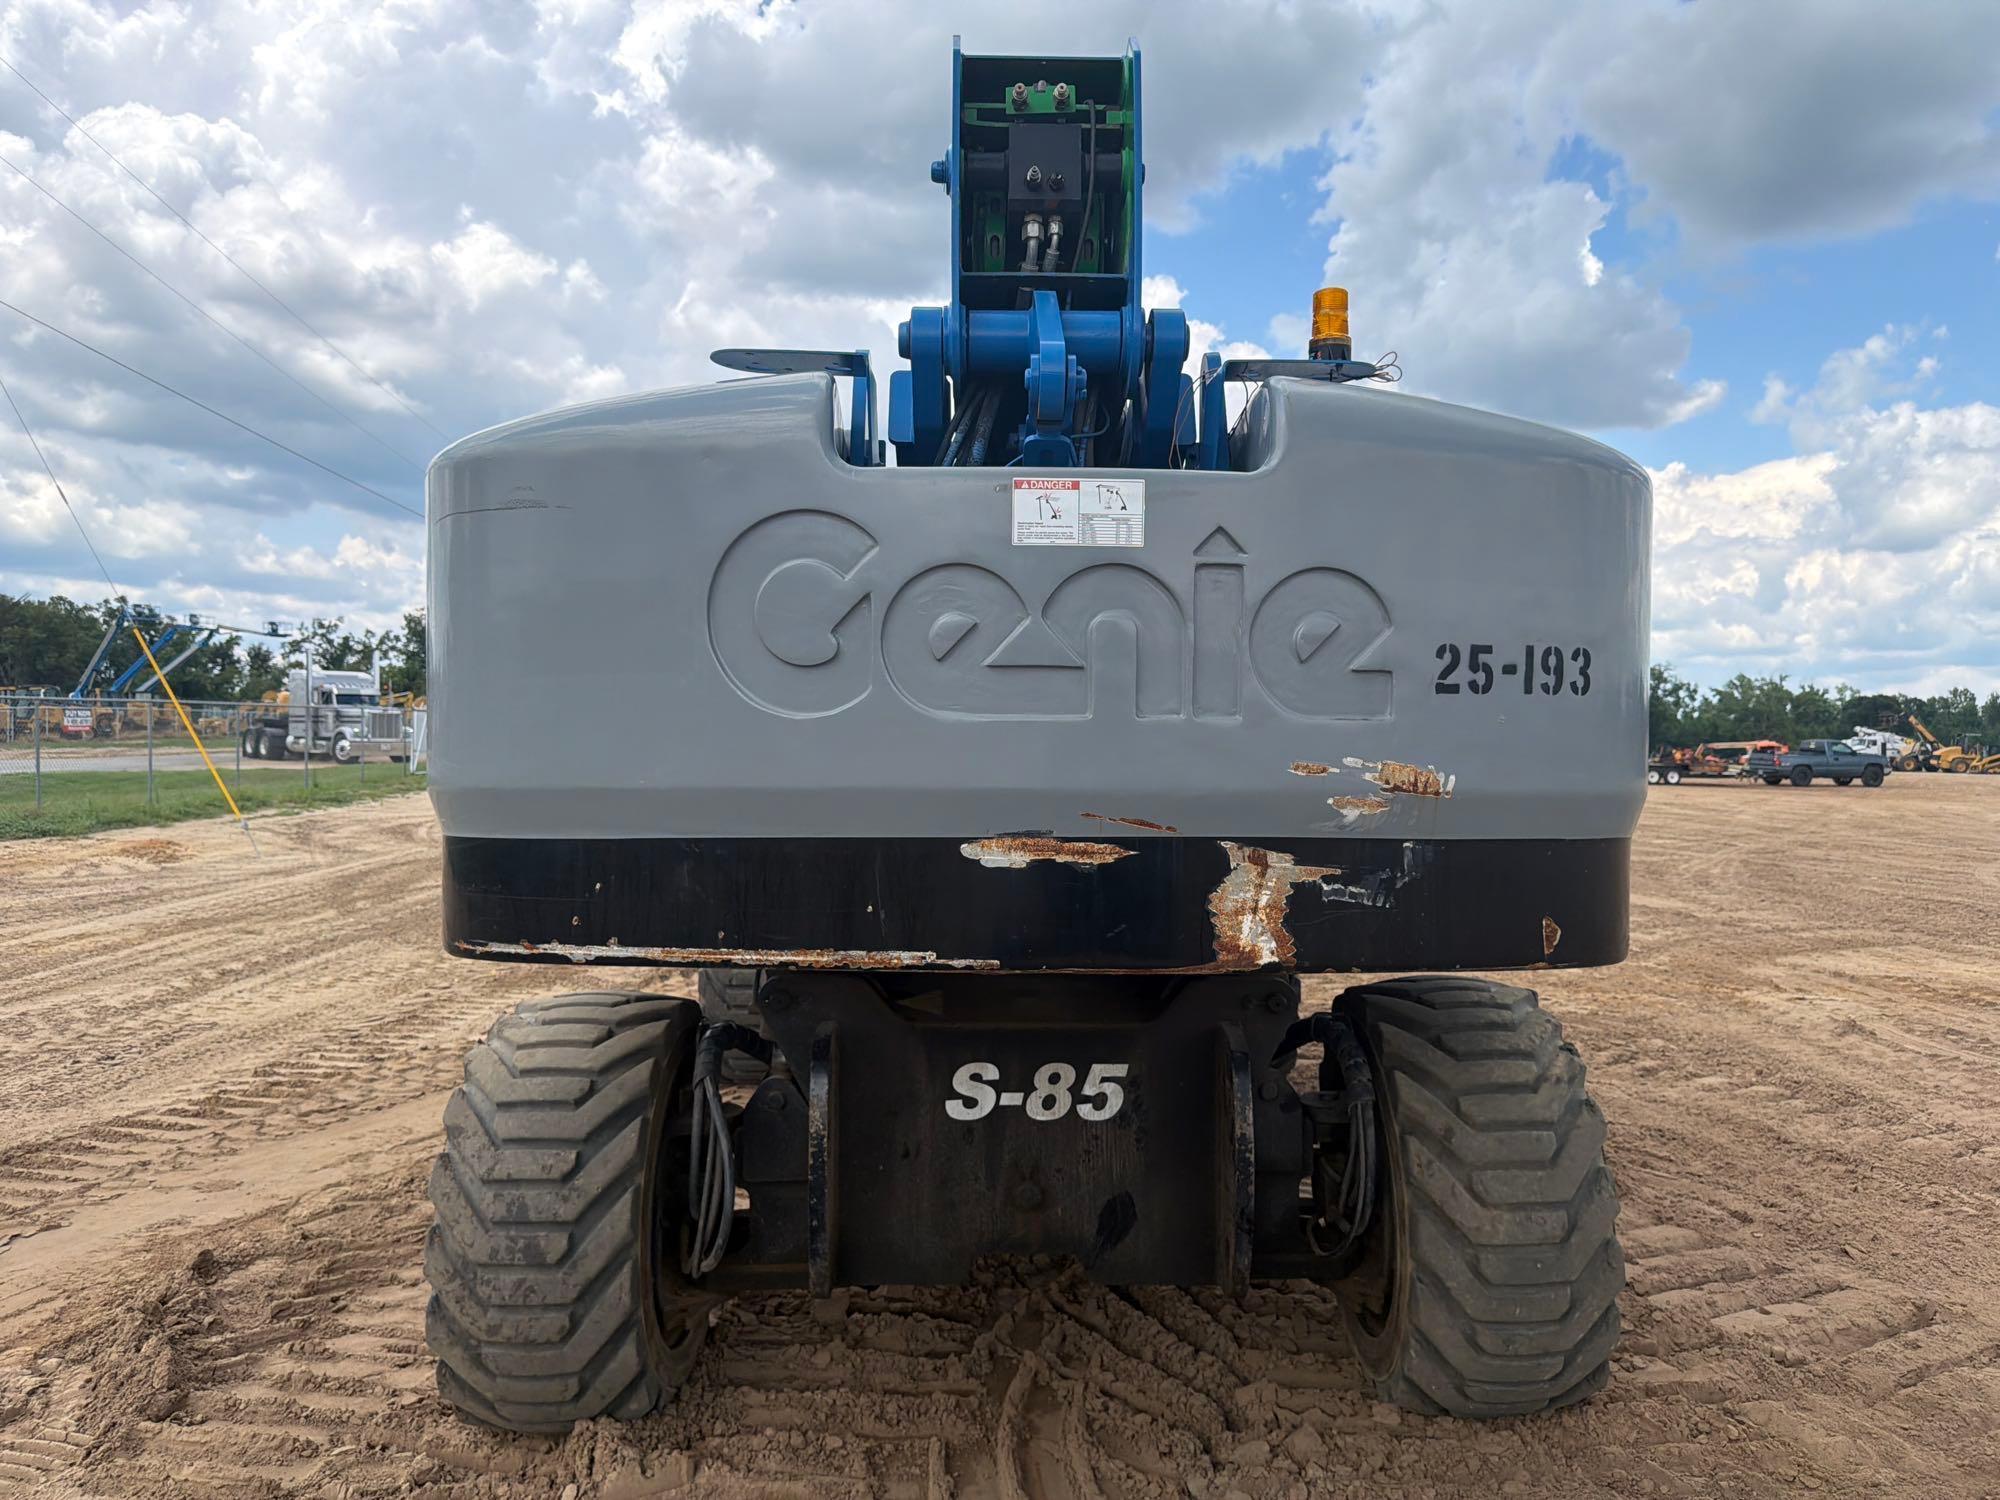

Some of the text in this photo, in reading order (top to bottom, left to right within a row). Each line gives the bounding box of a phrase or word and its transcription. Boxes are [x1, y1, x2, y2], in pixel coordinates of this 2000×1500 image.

[1030, 480, 1072, 489] DANGER
[707, 508, 1394, 720] Genie
[1435, 643, 1592, 696] 25-193
[945, 1062, 1129, 1121] S-85
